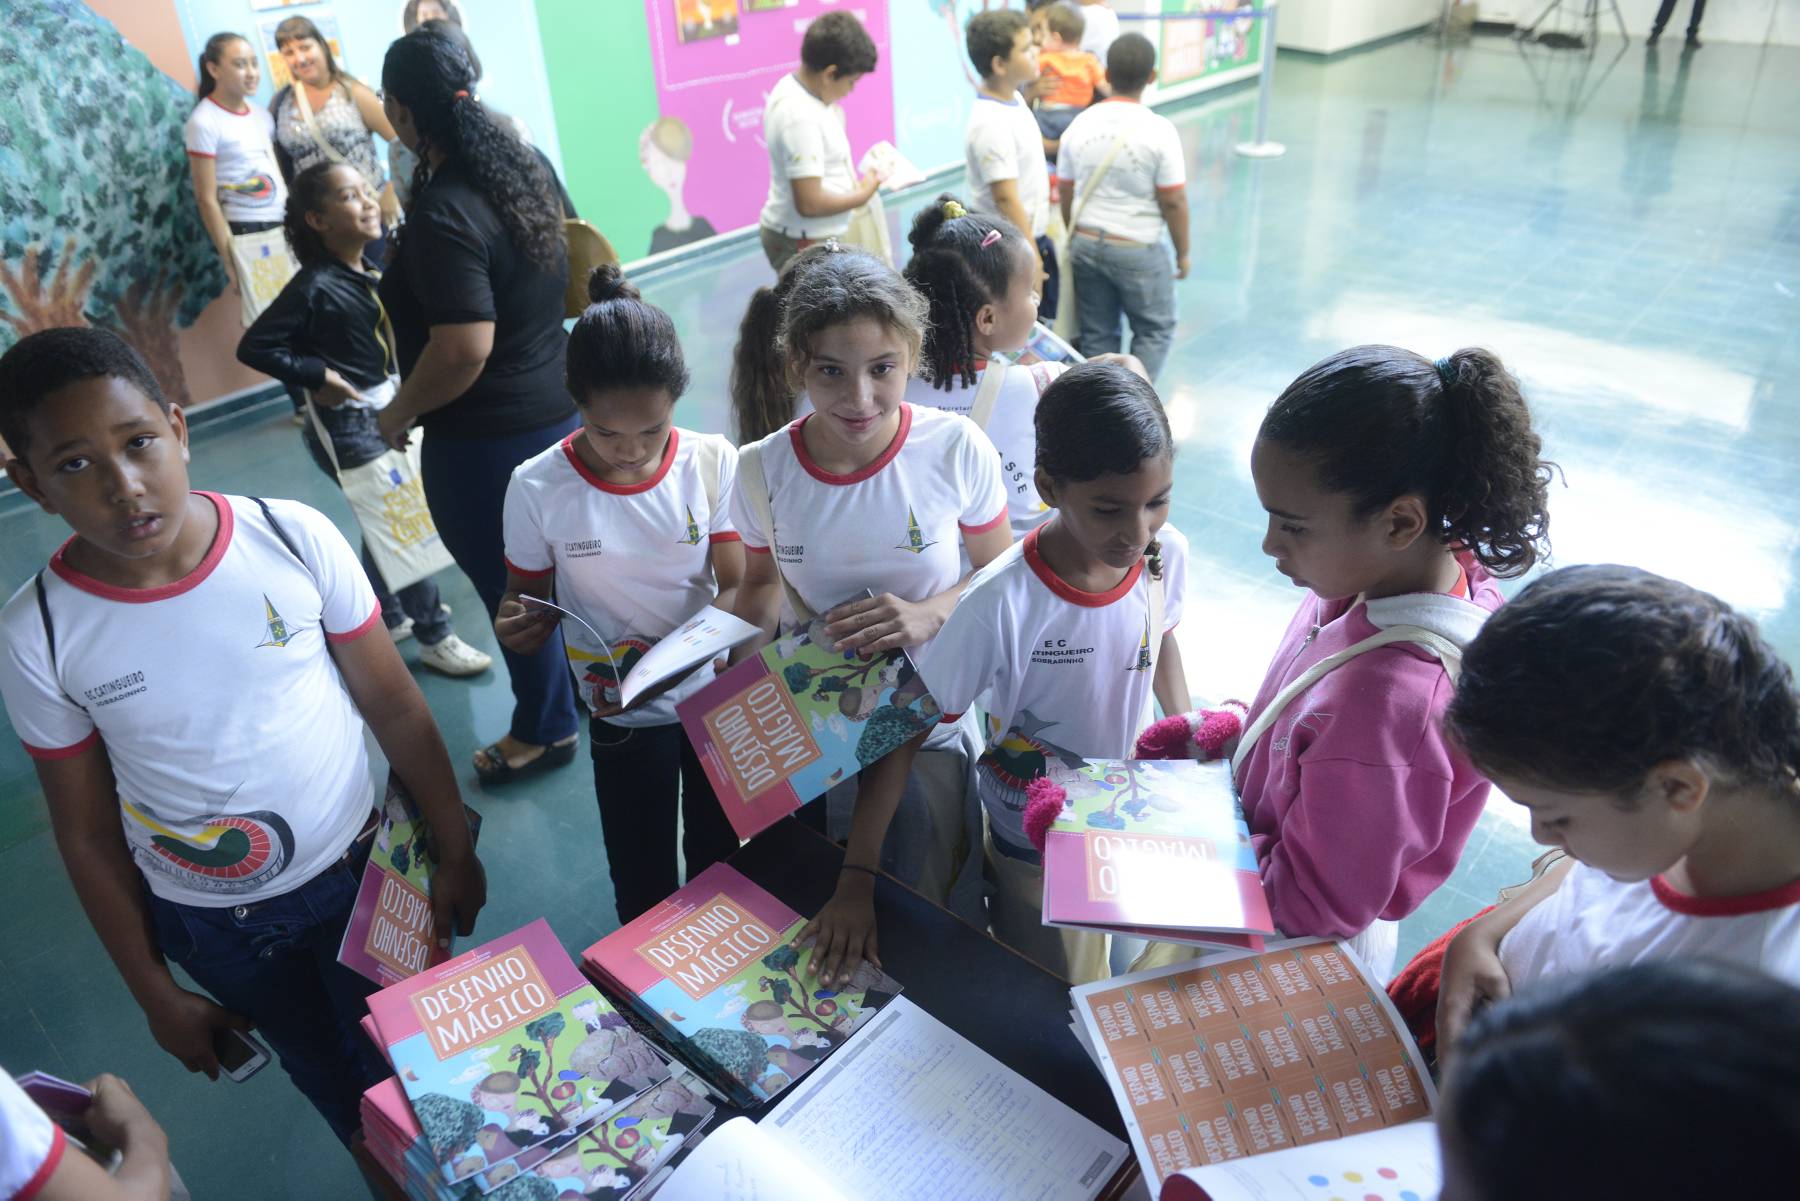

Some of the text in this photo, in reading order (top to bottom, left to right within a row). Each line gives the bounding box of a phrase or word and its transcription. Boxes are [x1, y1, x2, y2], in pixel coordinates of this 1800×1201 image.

[1044, 640, 1053, 648] E
[94, 670, 144, 698] CATINGUEIRO
[748, 682, 812, 768] MÁGICO
[715, 704, 776, 791] DESENHO
[382, 878, 435, 938] MÁGICO
[373, 916, 428, 973] DESENHO
[648, 905, 740, 968] DESENHO
[676, 924, 770, 992] MÁGICO
[1310, 954, 1338, 985] DESENHO
[420, 957, 527, 1021] DESENHO
[1228, 973, 1255, 1008] DESENHO
[1269, 964, 1296, 996] DESENHO
[436, 983, 545, 1050] MÁGICO
[1140, 994, 1167, 1030] DESENHO
[1184, 984, 1211, 1018] DESENHO
[1097, 1004, 1122, 1042] DESENHO
[1301, 1018, 1328, 1055] DESENHO
[1343, 1007, 1372, 1043] DESENHO
[1213, 1042, 1241, 1080] DESENHO
[1258, 1030, 1286, 1068] DESENHO
[1122, 1066, 1148, 1106] DESENHO
[1168, 1054, 1195, 1093] DESENHO
[1376, 1069, 1402, 1110] DESENHO
[1288, 1094, 1315, 1136] DESENHO
[1332, 1082, 1360, 1123] DESENHO
[1196, 1120, 1224, 1164] DESENHO
[1243, 1107, 1270, 1150] DESENHO
